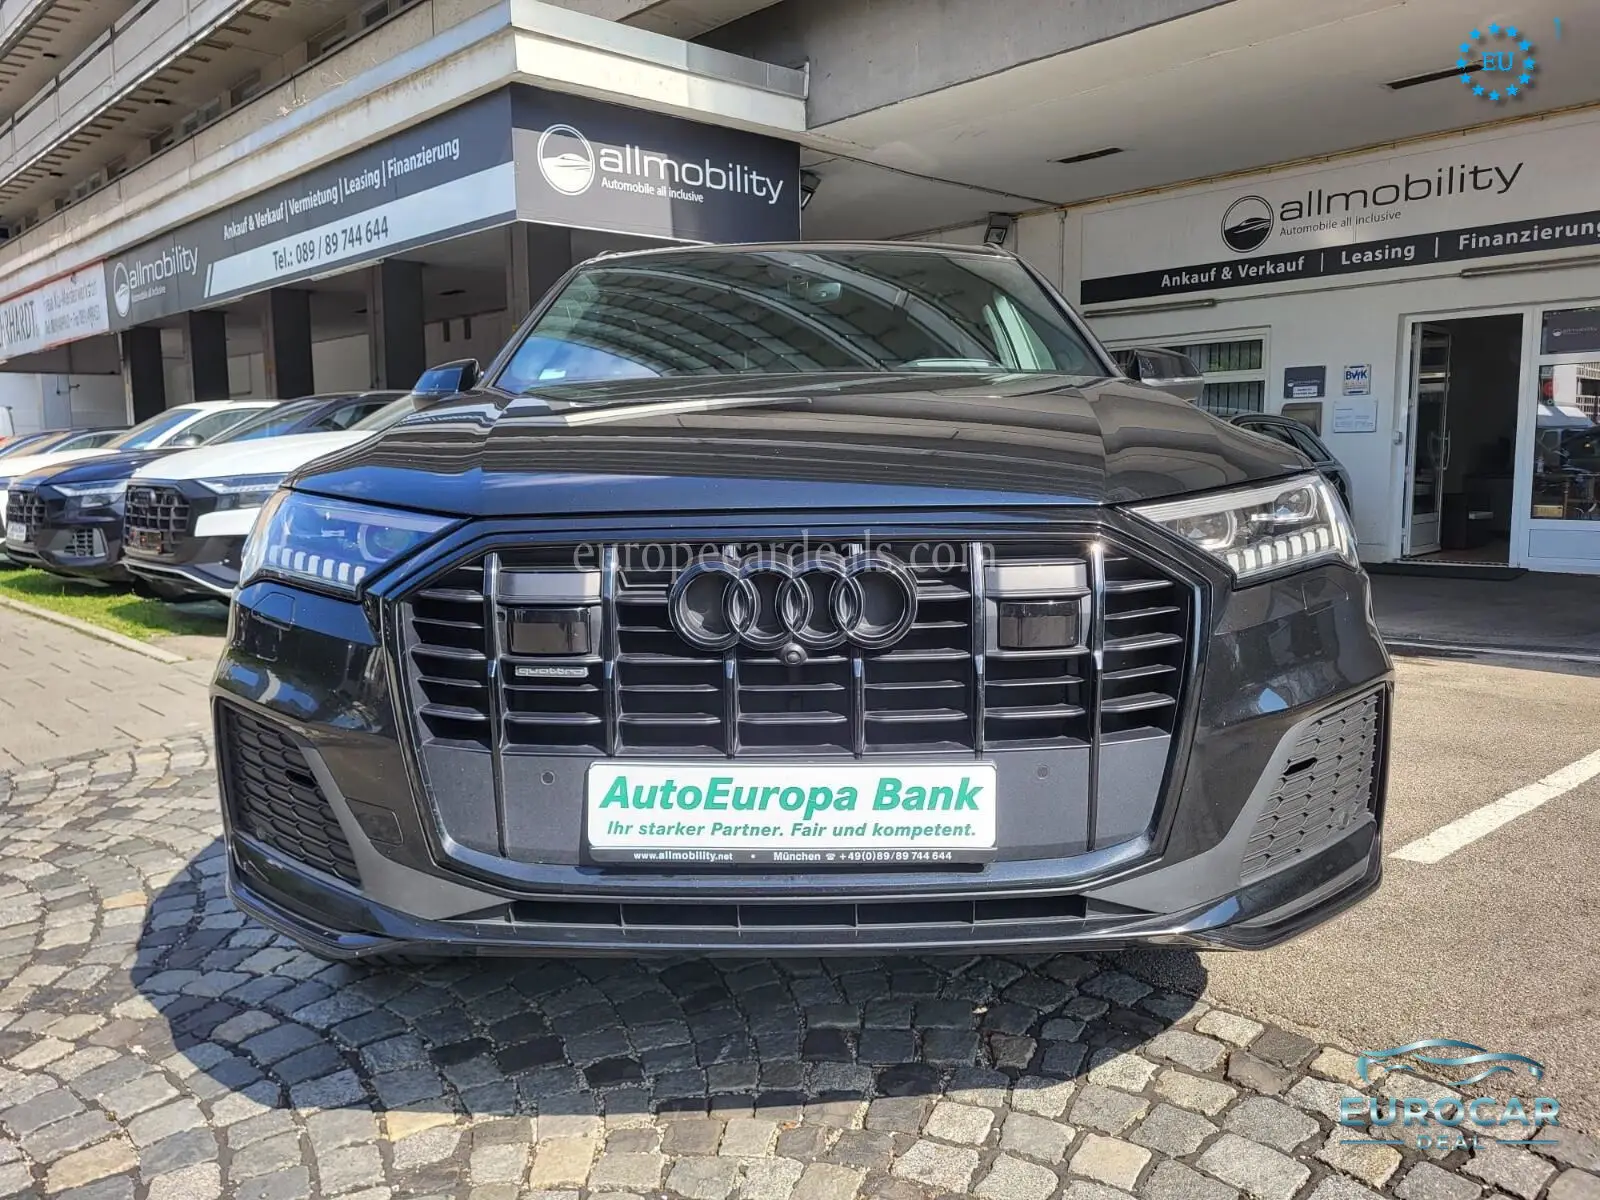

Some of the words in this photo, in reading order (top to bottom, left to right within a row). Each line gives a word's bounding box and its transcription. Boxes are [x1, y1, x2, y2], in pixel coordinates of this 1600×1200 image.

[223, 215, 248, 240] Ankauf
[248, 215, 255, 230] &
[255, 201, 284, 229] Verkauf
[288, 185, 338, 216] Vermietung
[344, 168, 380, 196] Leasing
[387, 138, 460, 179] Finanzierung
[600, 143, 784, 205] allmobility
[601, 177, 655, 196] Automobile
[656, 185, 667, 197] all
[669, 187, 704, 203] inclusive
[1280, 161, 1524, 222] allmobility
[272, 247, 294, 271] Tel.:
[295, 240, 315, 264] 089
[324, 232, 338, 256] 89
[341, 224, 362, 251] 744
[365, 215, 388, 243] 644
[1279, 219, 1338, 237] Automobile
[1340, 217, 1352, 228] all
[1354, 210, 1402, 226] inclusive
[129, 245, 198, 289] allmobility
[1160, 270, 1217, 288] Ankauf
[1221, 266, 1232, 280] &
[1237, 256, 1305, 279] Verkauf
[1341, 243, 1416, 266] Leasing
[1459, 221, 1600, 250] Finanzierun
[599, 775, 857, 820] AutoEuropa
[872, 776, 985, 812] Bank
[607, 821, 634, 836] Ihr
[638, 822, 706, 836] starker
[710, 822, 784, 837] Partner.
[790, 823, 825, 837] Fair
[831, 823, 866, 837] und
[872, 823, 977, 839] kompetent.
[633, 851, 734, 862] www.allmobility.net
[773, 851, 821, 861] München
[839, 851, 909, 862] +49(0)89/89
[911, 851, 930, 860] 744
[932, 851, 952, 860] 644
